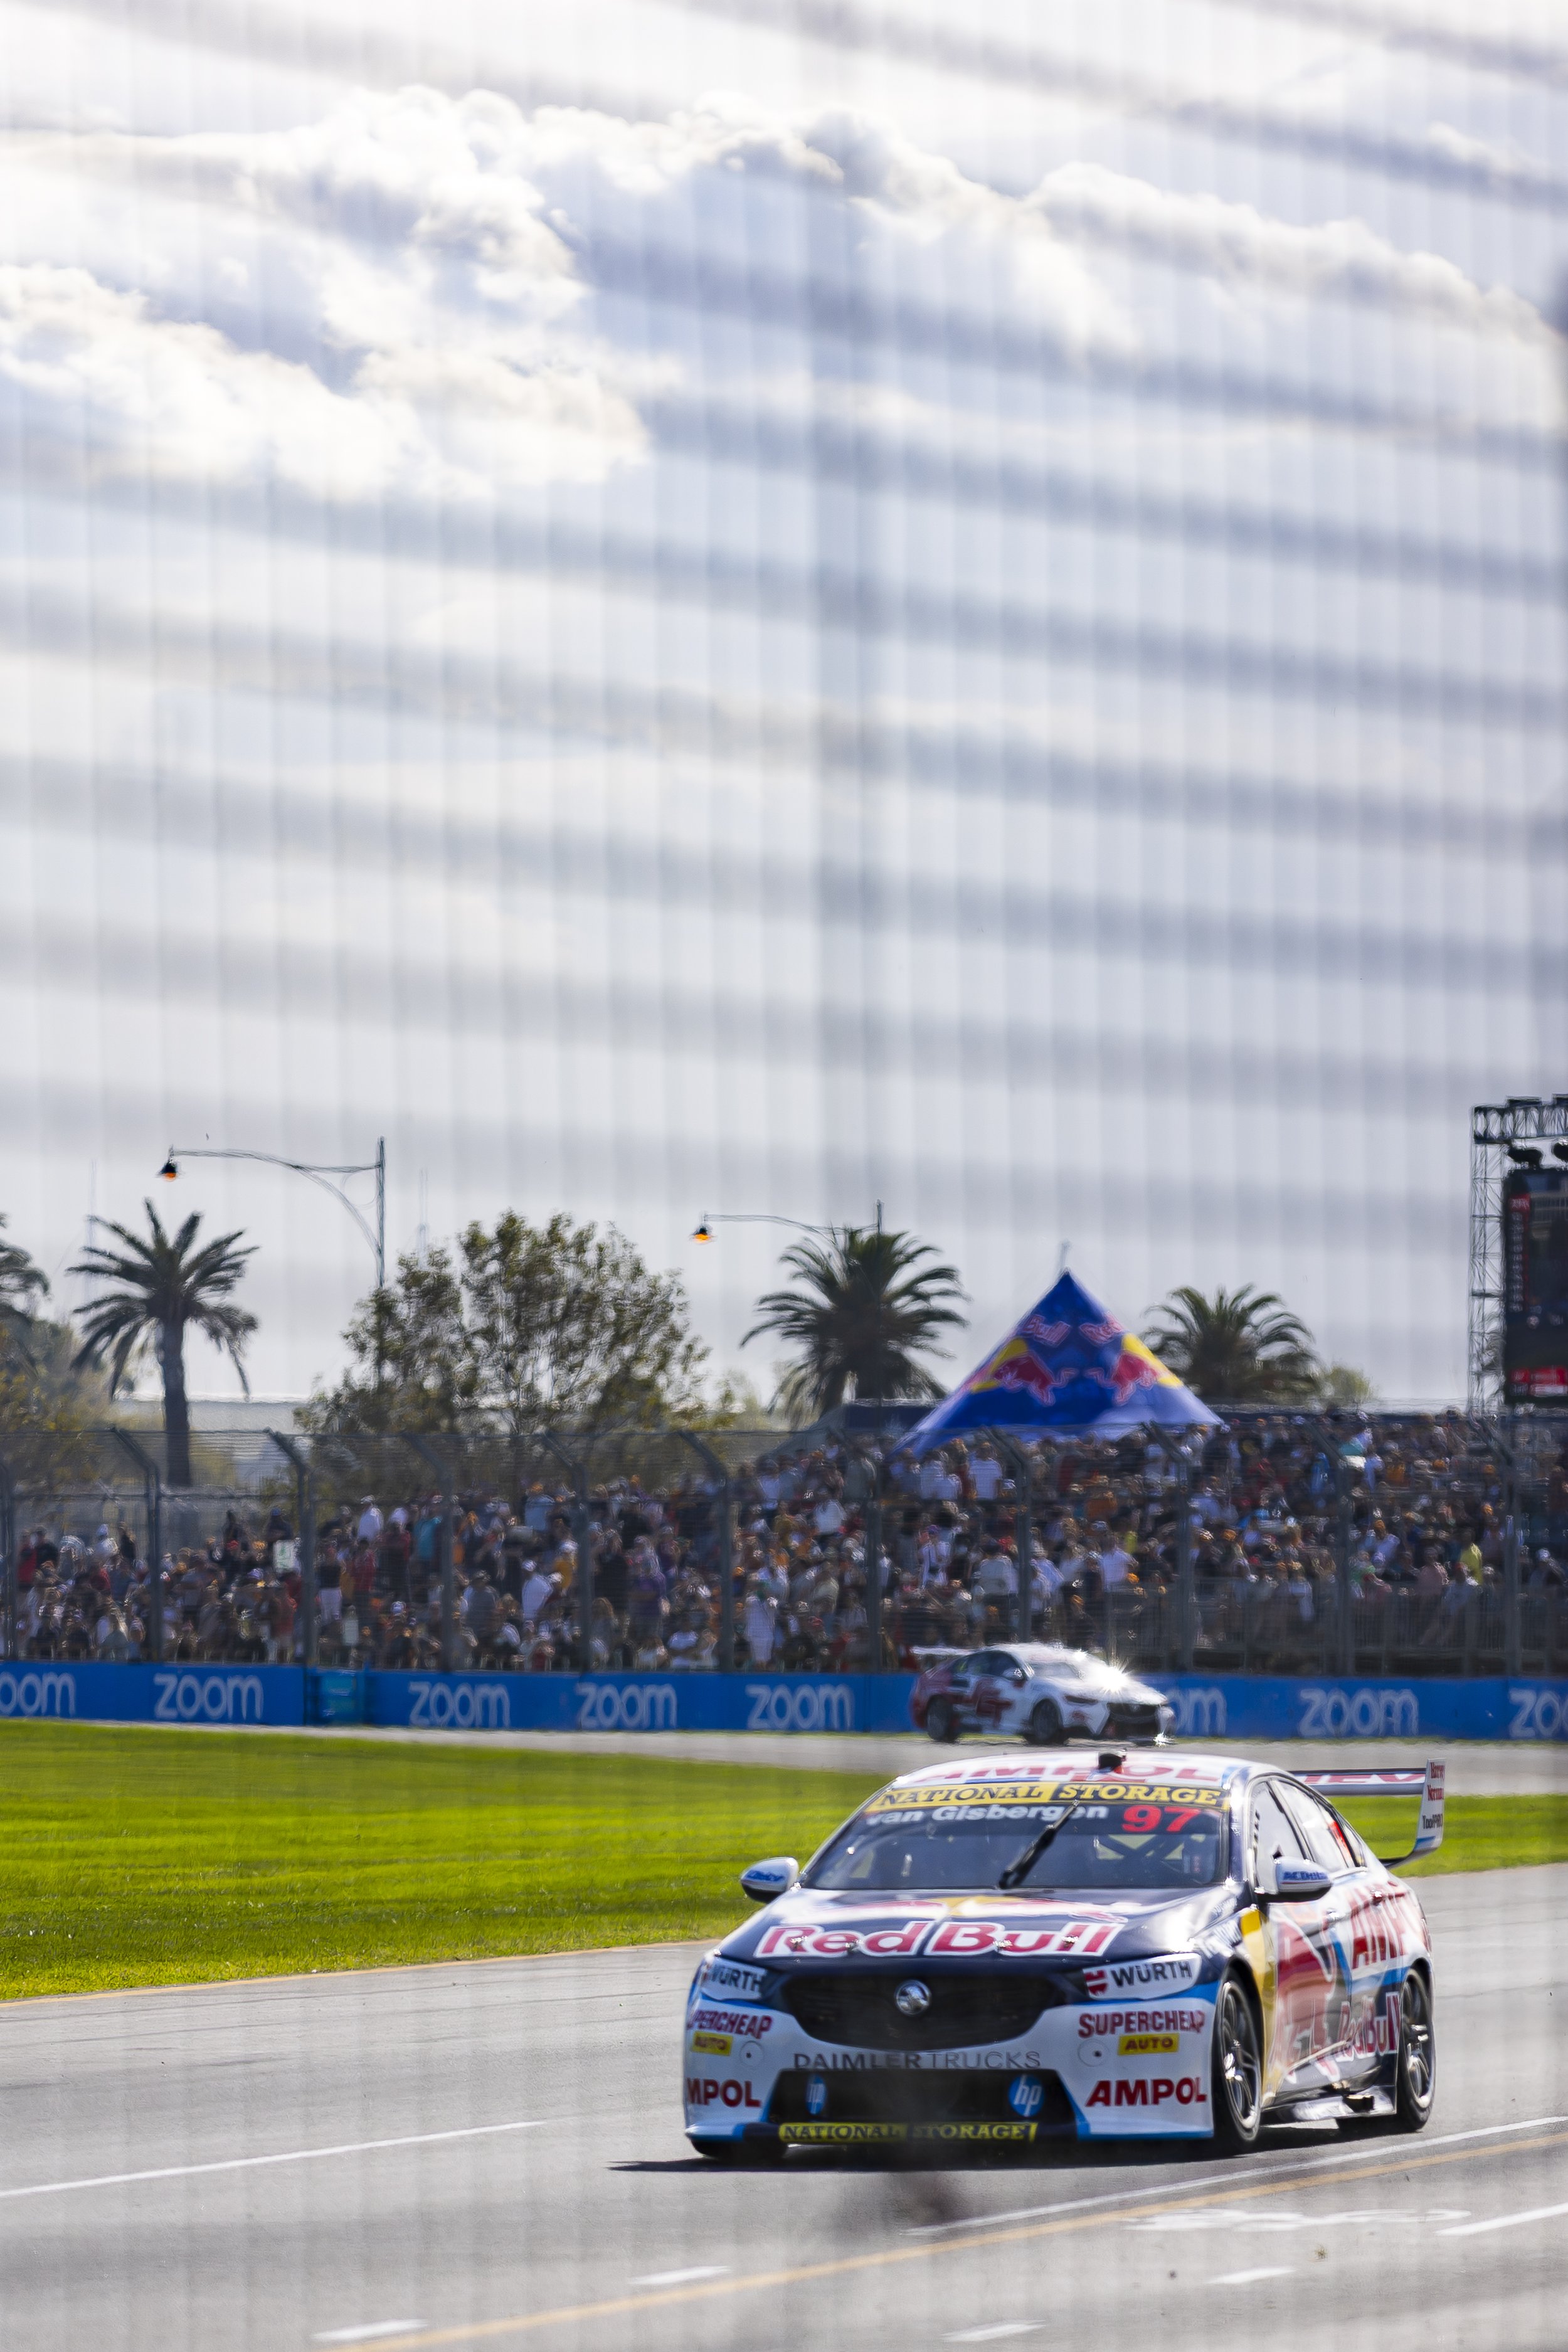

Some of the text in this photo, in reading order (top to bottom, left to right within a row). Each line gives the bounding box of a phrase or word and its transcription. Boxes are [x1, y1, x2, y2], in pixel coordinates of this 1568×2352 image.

[0, 1673, 77, 1717] oom
[880, 1784, 1221, 1806] NATIONAL STORAGE
[1121, 1805, 1200, 1833] 97
[756, 1921, 1121, 1957] Red Bull
[1111, 1961, 1192, 1988] WÜRTH
[1078, 2010, 1205, 2038] SUPERCHEAP
[1125, 2037, 1173, 2050] AUTO
[793, 2050, 1041, 2069] DAIMLER TRUCKS
[687, 2077, 762, 2108] MPOL
[1013, 2074, 1043, 2117] hp
[1085, 2077, 1207, 2107] AMPOL
